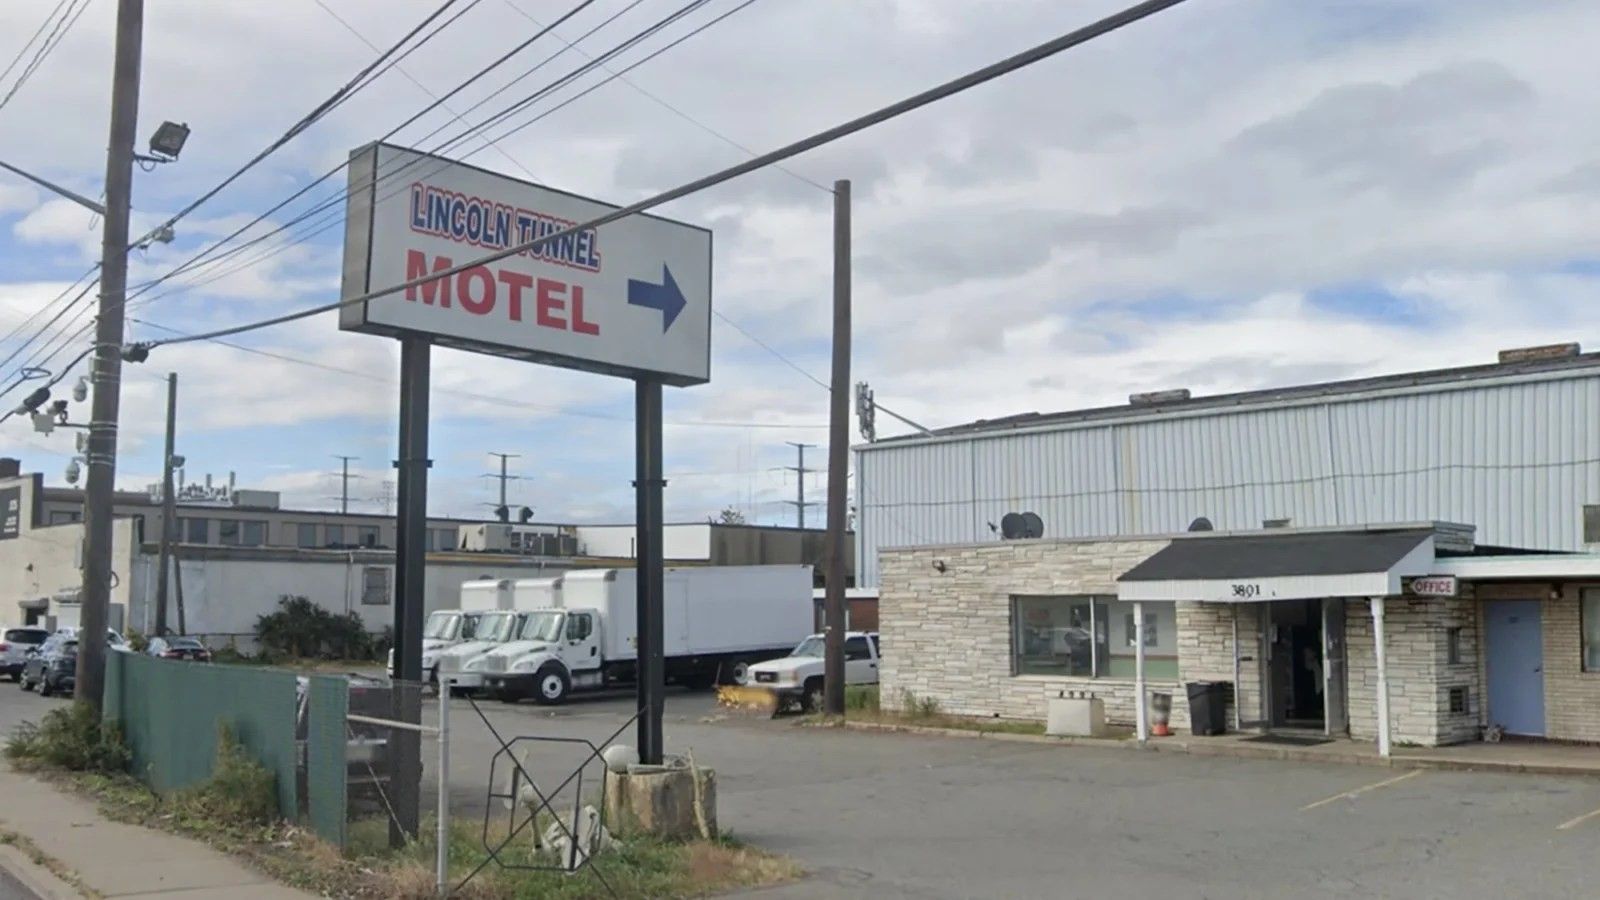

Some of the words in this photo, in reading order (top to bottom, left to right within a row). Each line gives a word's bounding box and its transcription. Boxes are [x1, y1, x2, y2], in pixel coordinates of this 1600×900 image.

[412, 184, 512, 249] LINCOLN
[516, 211, 600, 271] TUNNEL
[405, 249, 599, 336] MOTEL
[1231, 584, 1261, 598] 3801
[1415, 581, 1452, 593] OFFICE
